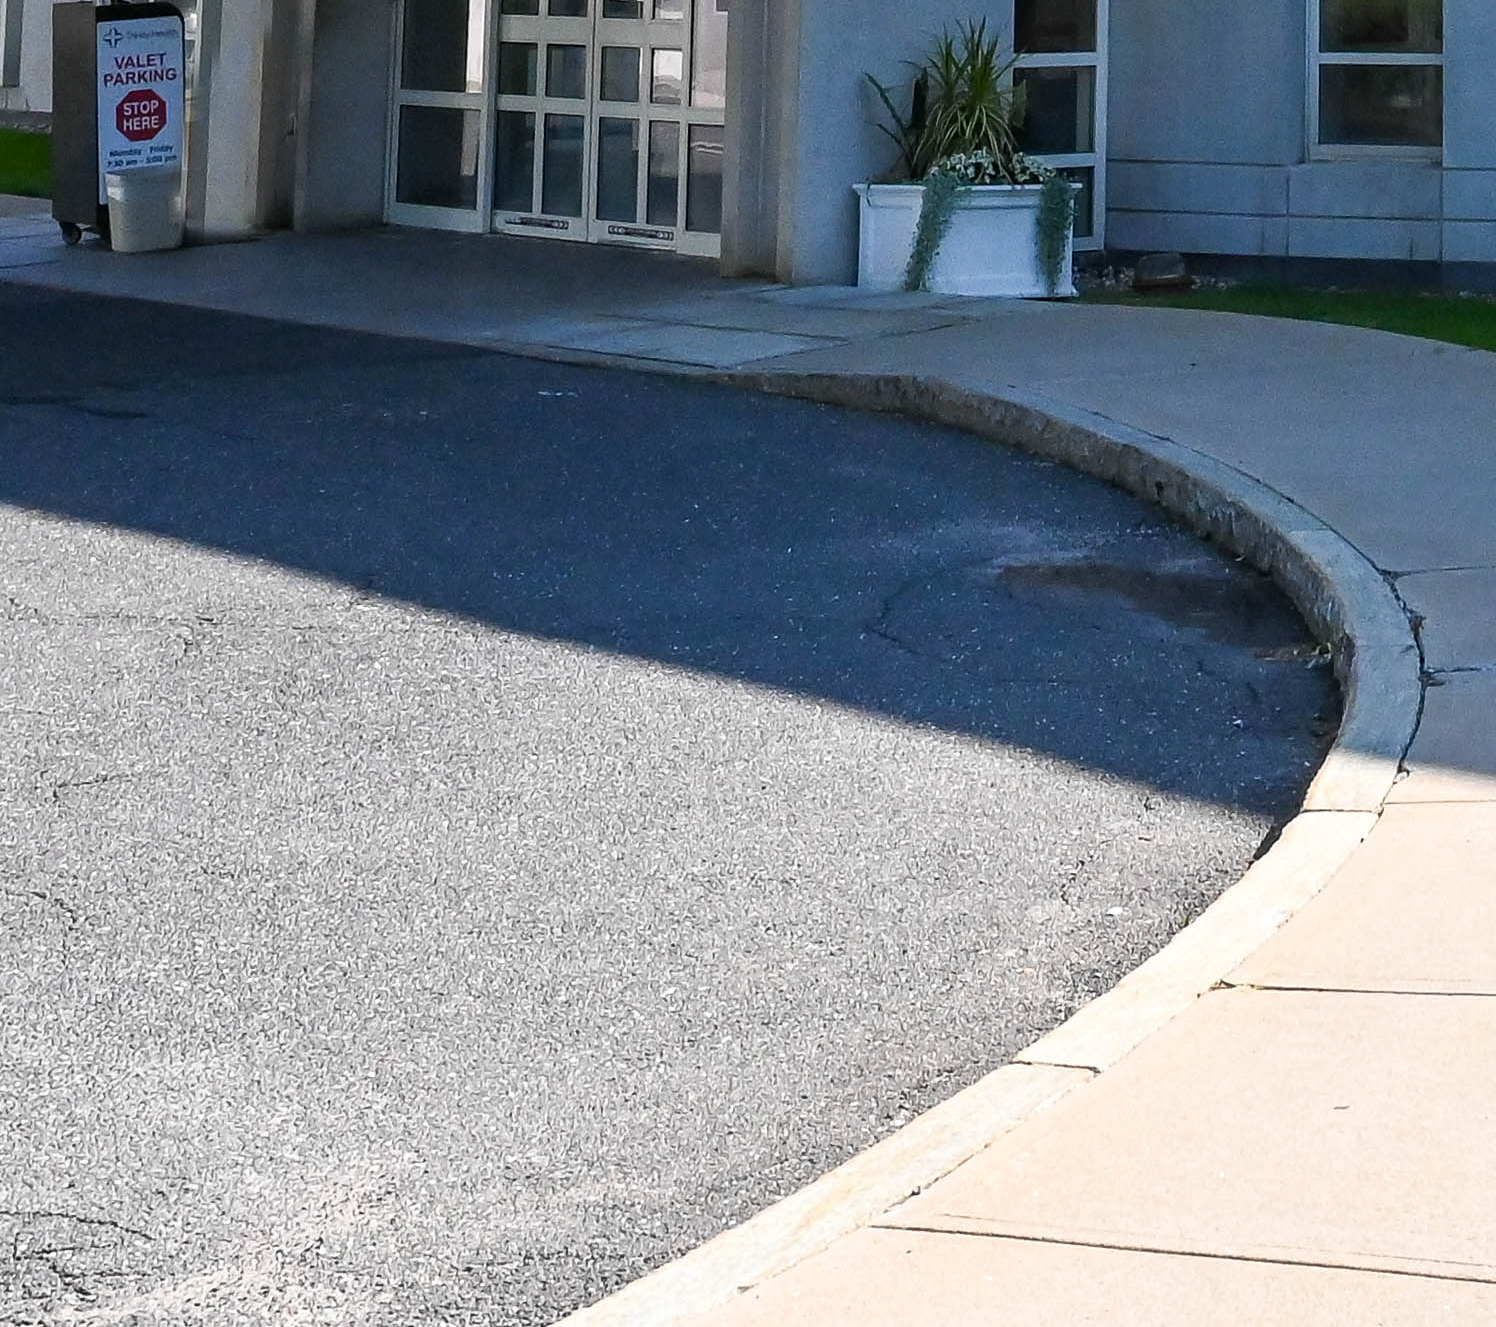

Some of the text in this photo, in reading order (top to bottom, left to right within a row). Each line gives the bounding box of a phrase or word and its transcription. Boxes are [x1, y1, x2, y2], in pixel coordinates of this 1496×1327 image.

[114, 52, 166, 69] VALET
[104, 68, 177, 88] PARKING
[124, 100, 159, 115] STOP
[124, 116, 159, 131] HERE
